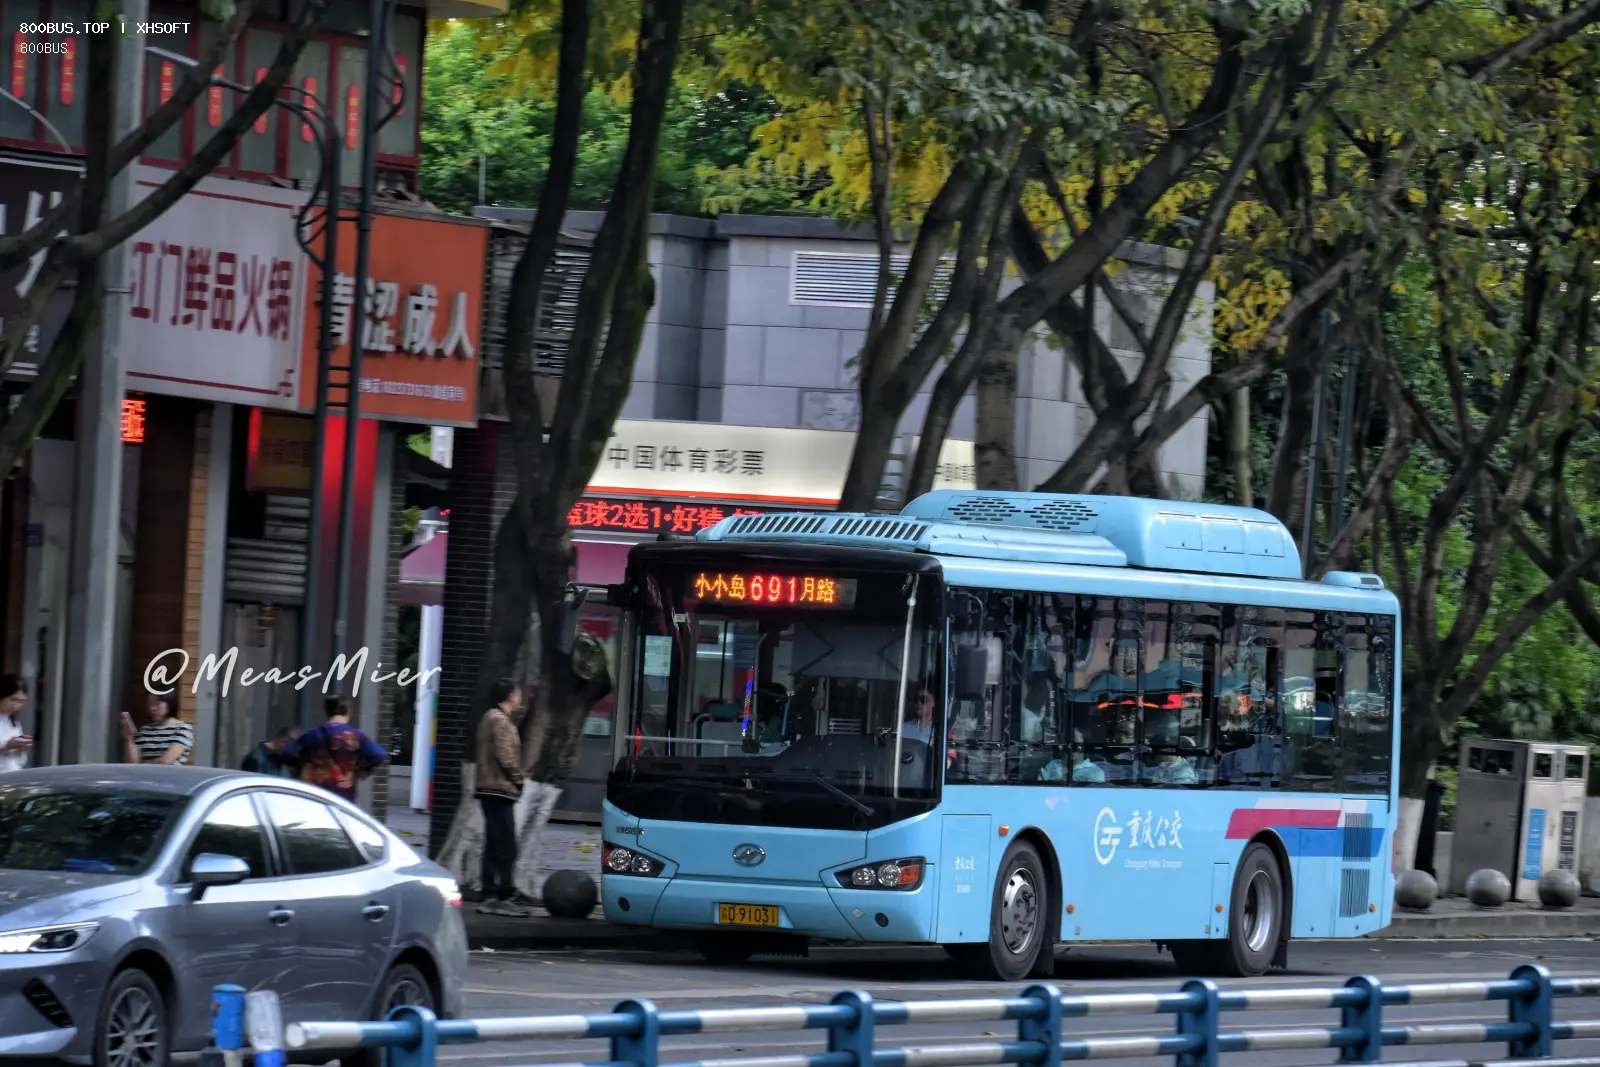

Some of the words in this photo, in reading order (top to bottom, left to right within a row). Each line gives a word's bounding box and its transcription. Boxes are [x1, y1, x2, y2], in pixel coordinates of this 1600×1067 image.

[607, 443, 765, 476] 中国体育彩票
[1126, 809, 1184, 849] 重庆公交
